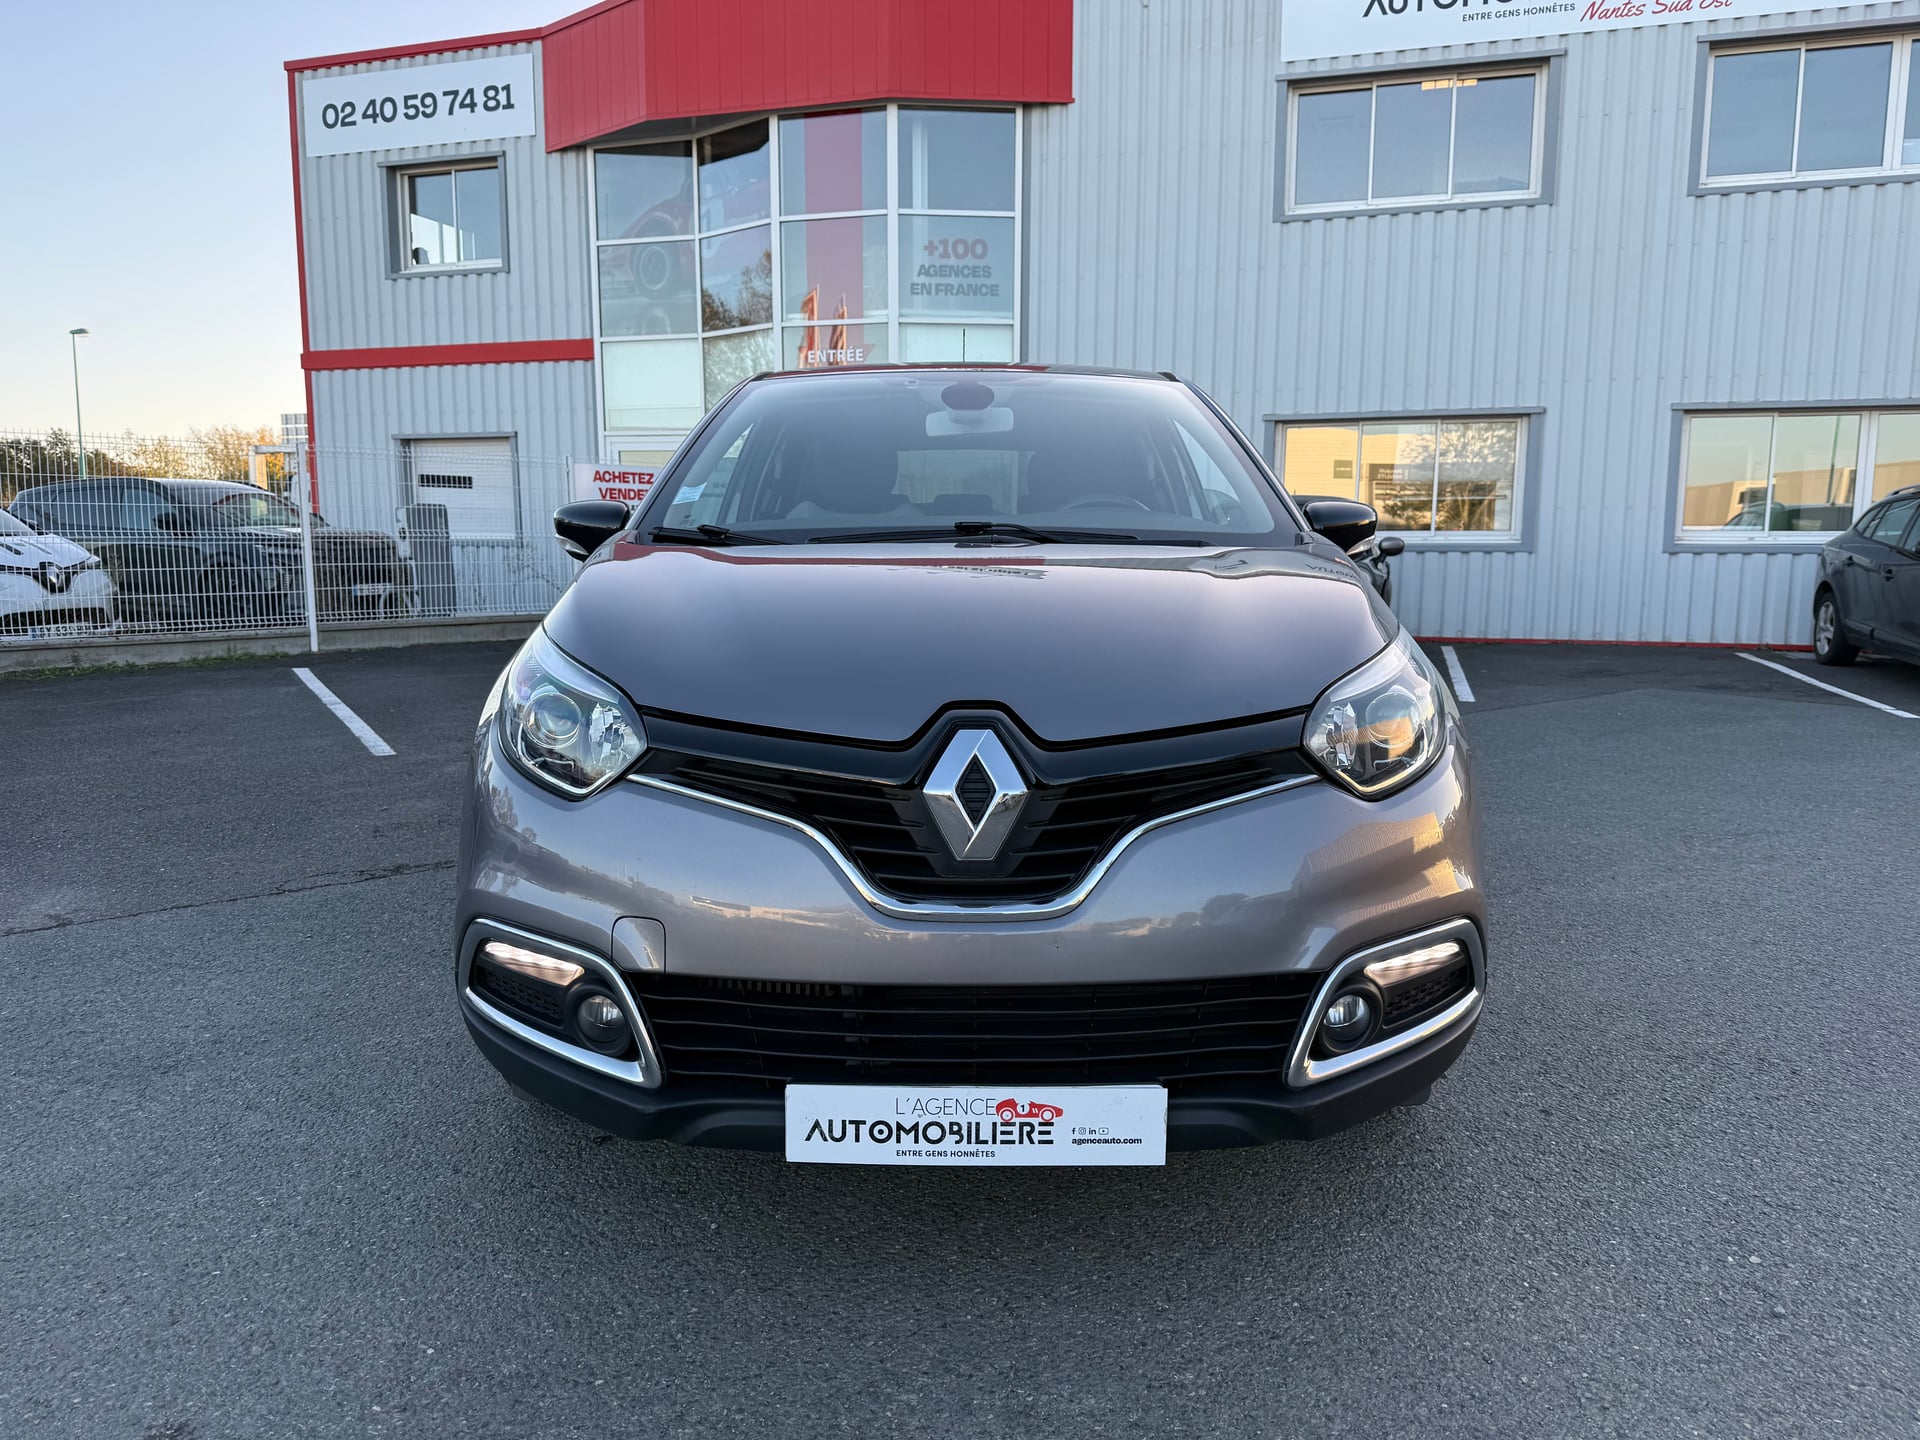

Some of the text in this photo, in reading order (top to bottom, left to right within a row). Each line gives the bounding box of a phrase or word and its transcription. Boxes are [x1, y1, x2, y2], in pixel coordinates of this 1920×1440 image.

[1462, 2, 1576, 22] ENTRE GENS HONNÊTES
[1580, 0, 1646, 22] Nantes
[322, 83, 515, 129] 02 40 59 74 81
[923, 237, 989, 260] +100
[916, 264, 992, 278] AGENCES
[909, 283, 1000, 297] EN FRANCE
[807, 345, 864, 363] ENTRÉE
[593, 470, 654, 484] ACHETEZ
[895, 1097, 996, 1116] L'AGENCE
[1071, 1137, 1142, 1146] agenceauto.com
[896, 1148, 996, 1158] ENTRE GENS HONNÊTES
